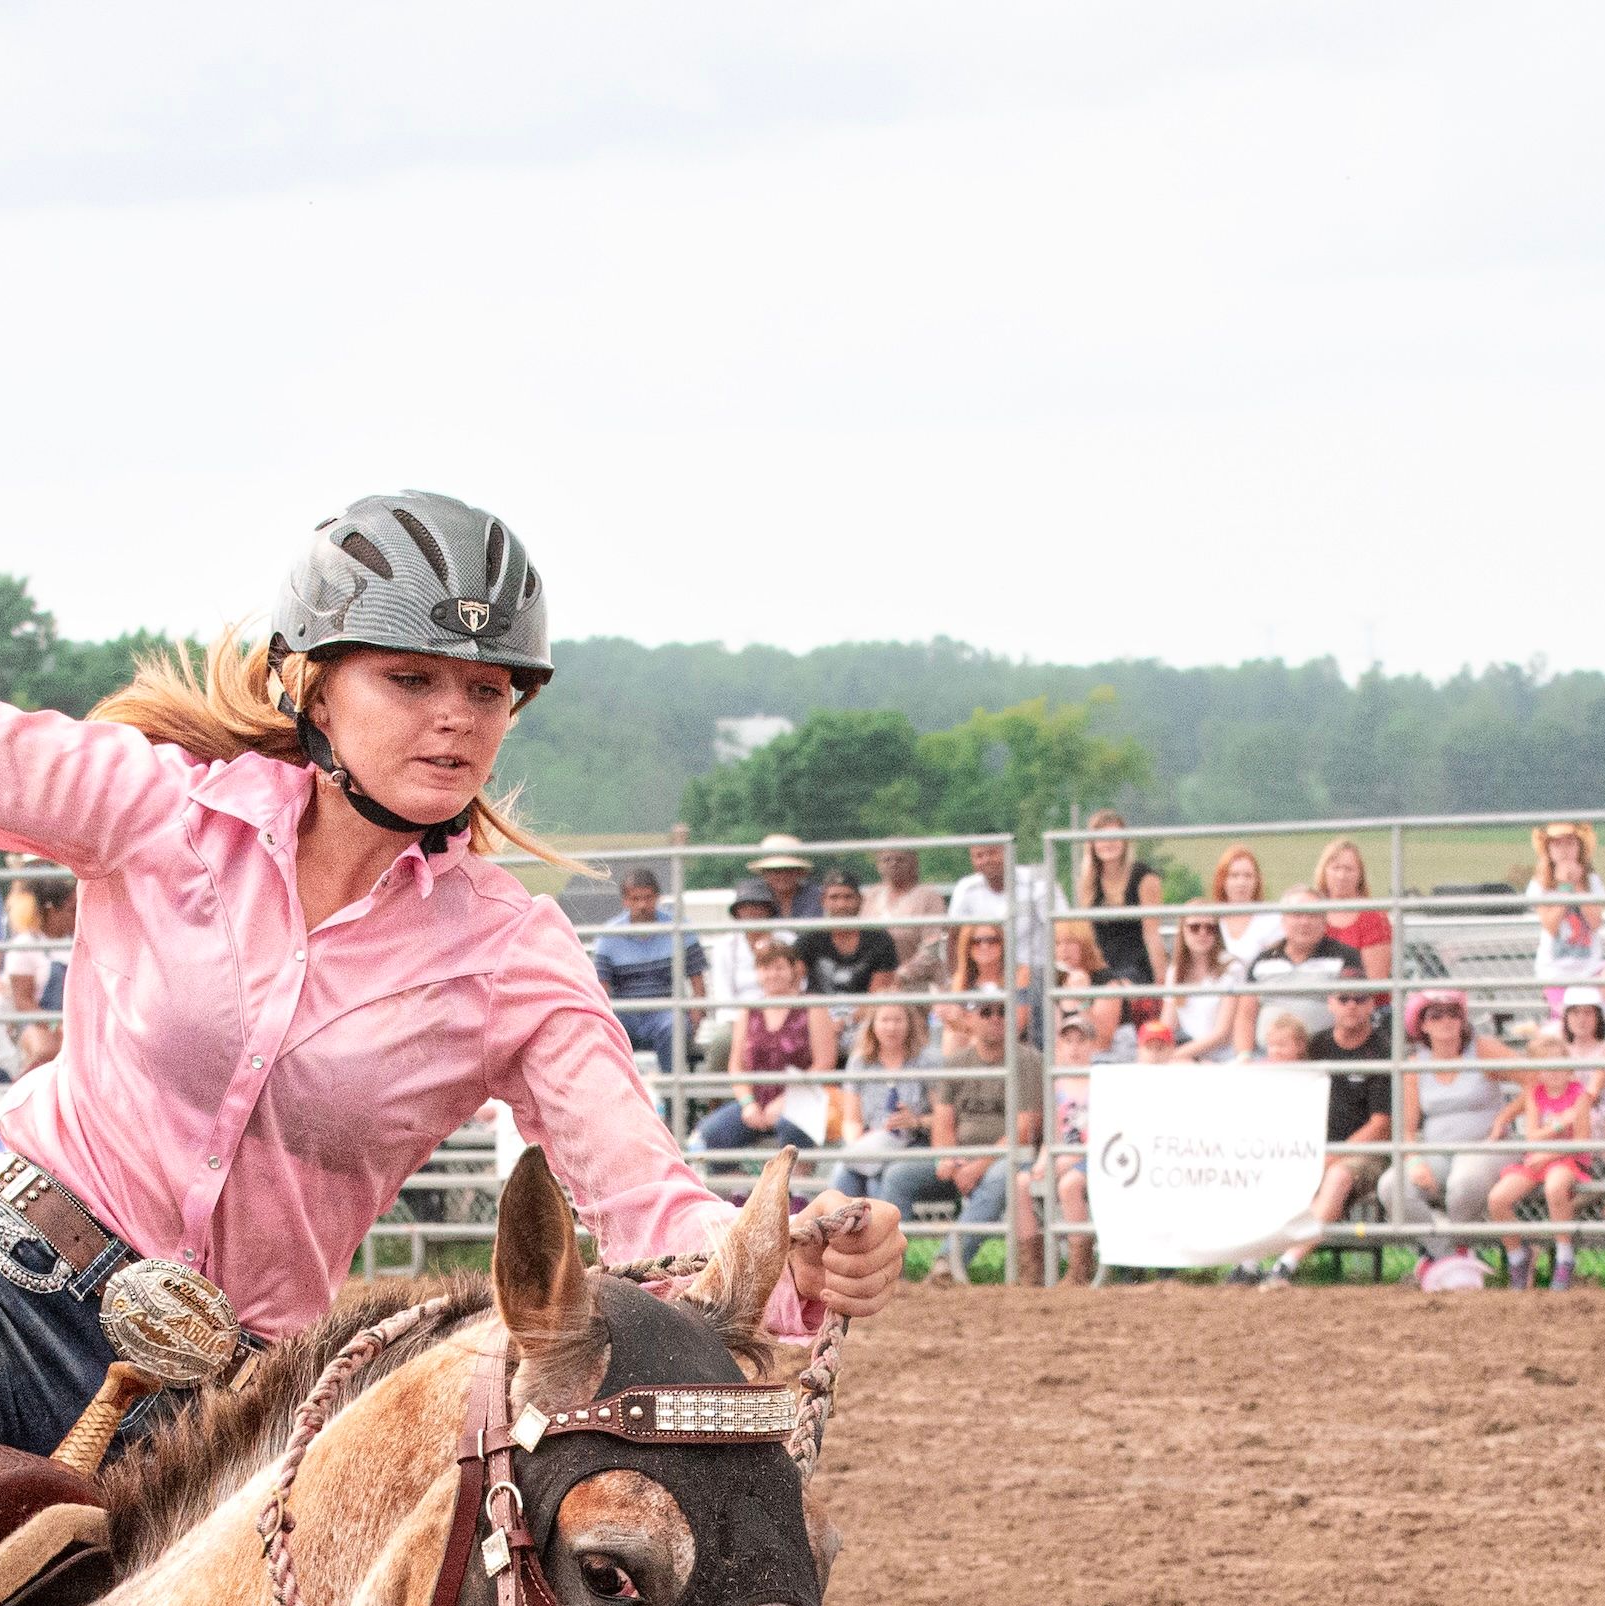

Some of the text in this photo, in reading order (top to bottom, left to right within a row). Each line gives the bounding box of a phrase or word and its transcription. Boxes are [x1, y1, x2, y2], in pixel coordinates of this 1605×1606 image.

[1151, 1135, 1319, 1161] FRANK COWAN
[1149, 1166, 1264, 1189] COMPANY
